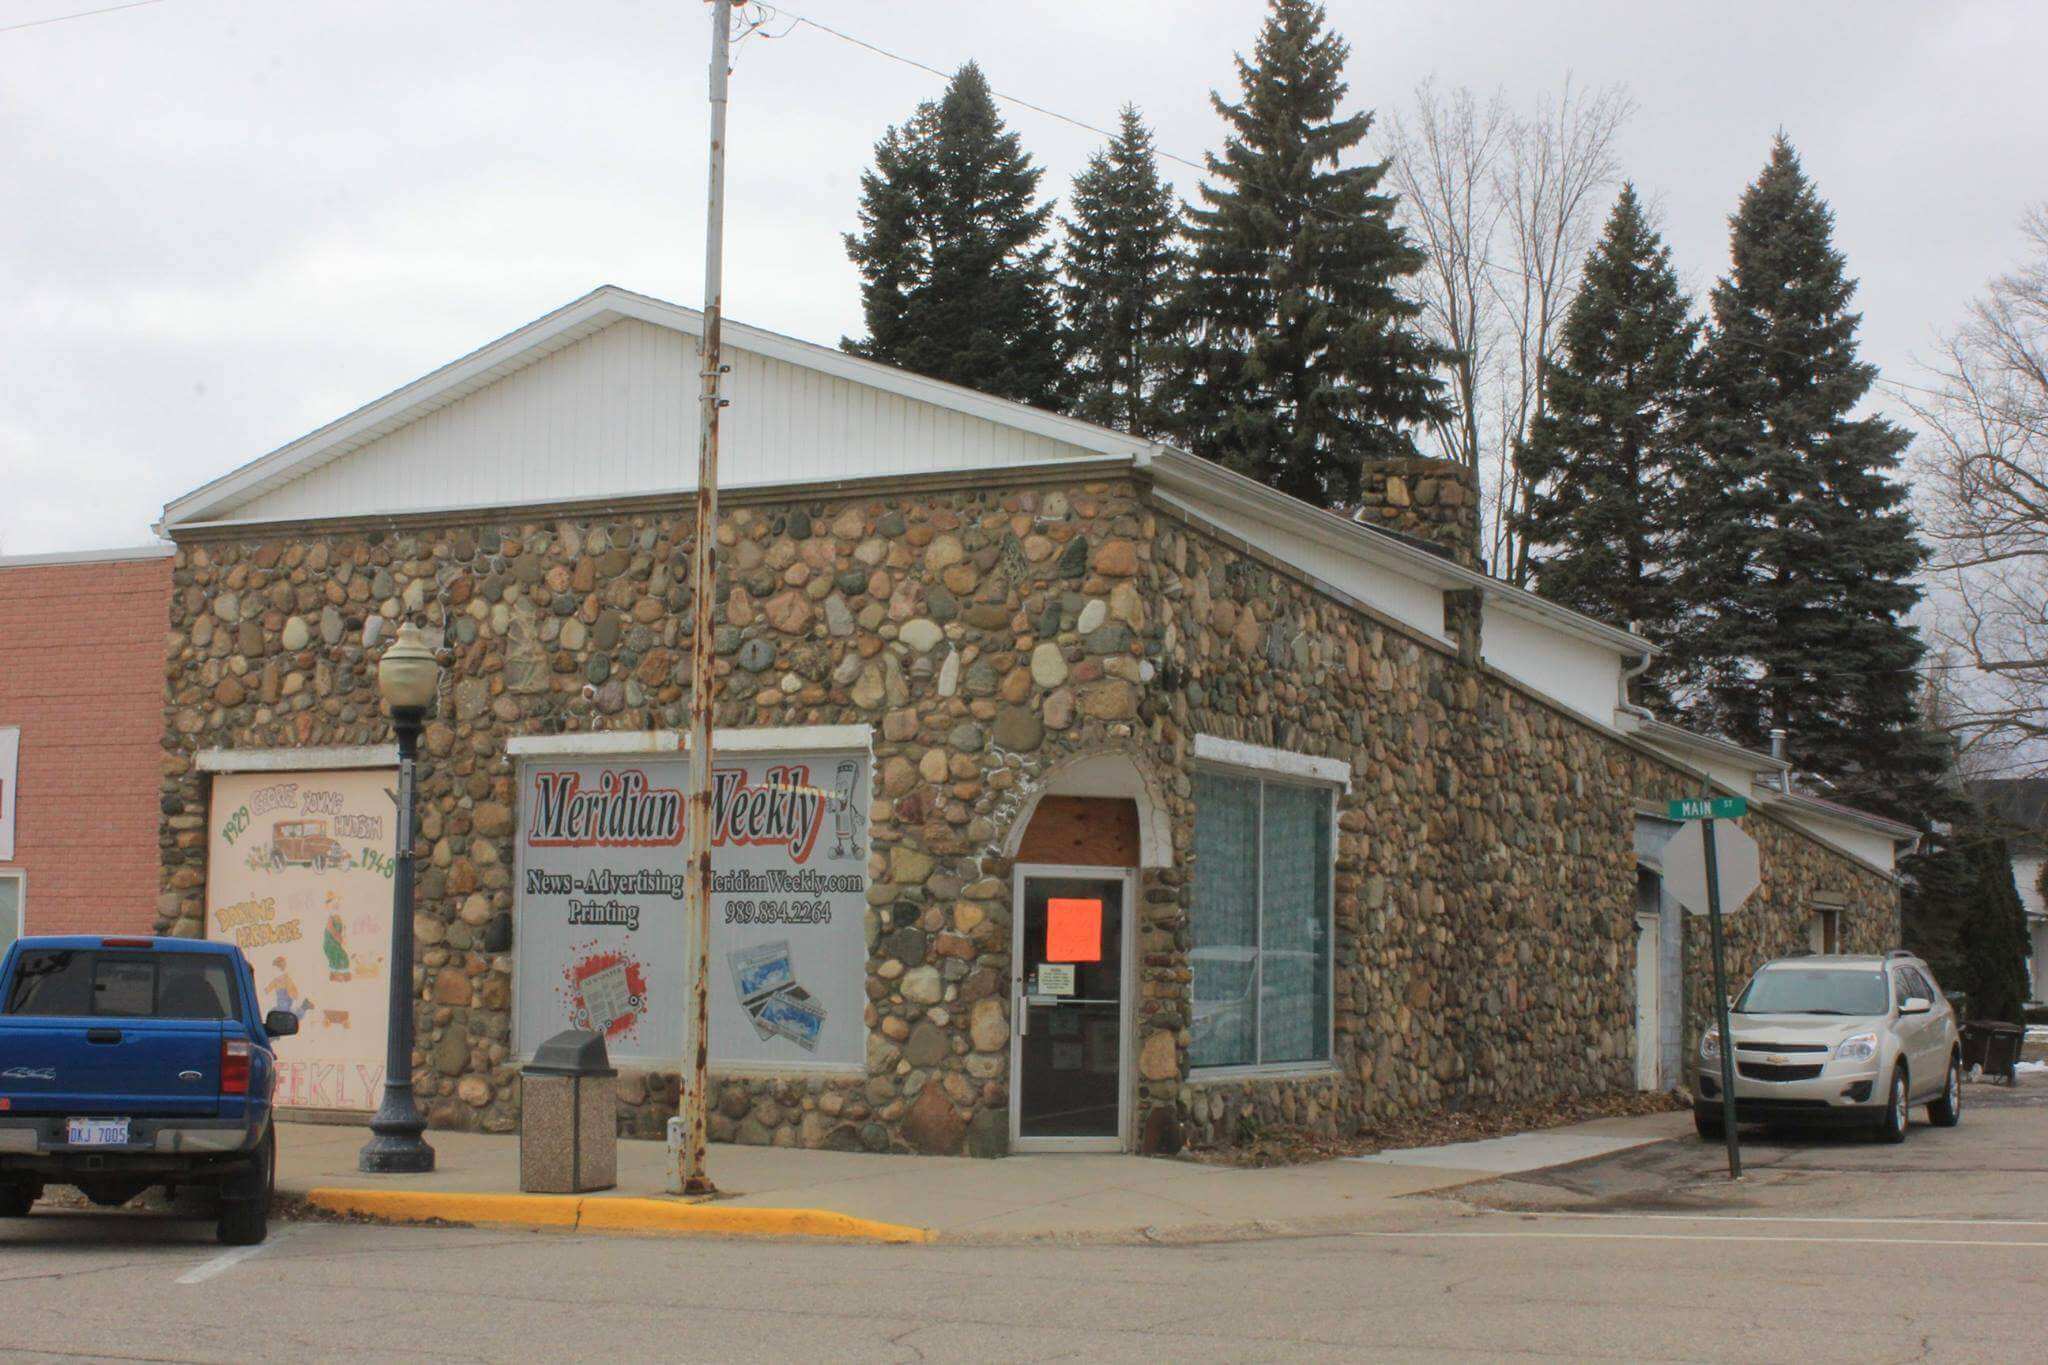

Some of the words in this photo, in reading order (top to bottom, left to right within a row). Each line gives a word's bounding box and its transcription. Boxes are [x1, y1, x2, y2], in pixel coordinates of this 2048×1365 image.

[529, 770, 686, 847] Meridian
[1682, 801, 1712, 817] MAIN
[1723, 799, 1733, 809] ST
[222, 805, 250, 846] 1929
[527, 869, 572, 895] News
[584, 869, 683, 899] Advertising
[568, 900, 640, 930] Printing
[725, 901, 832, 925] 989.834.2264
